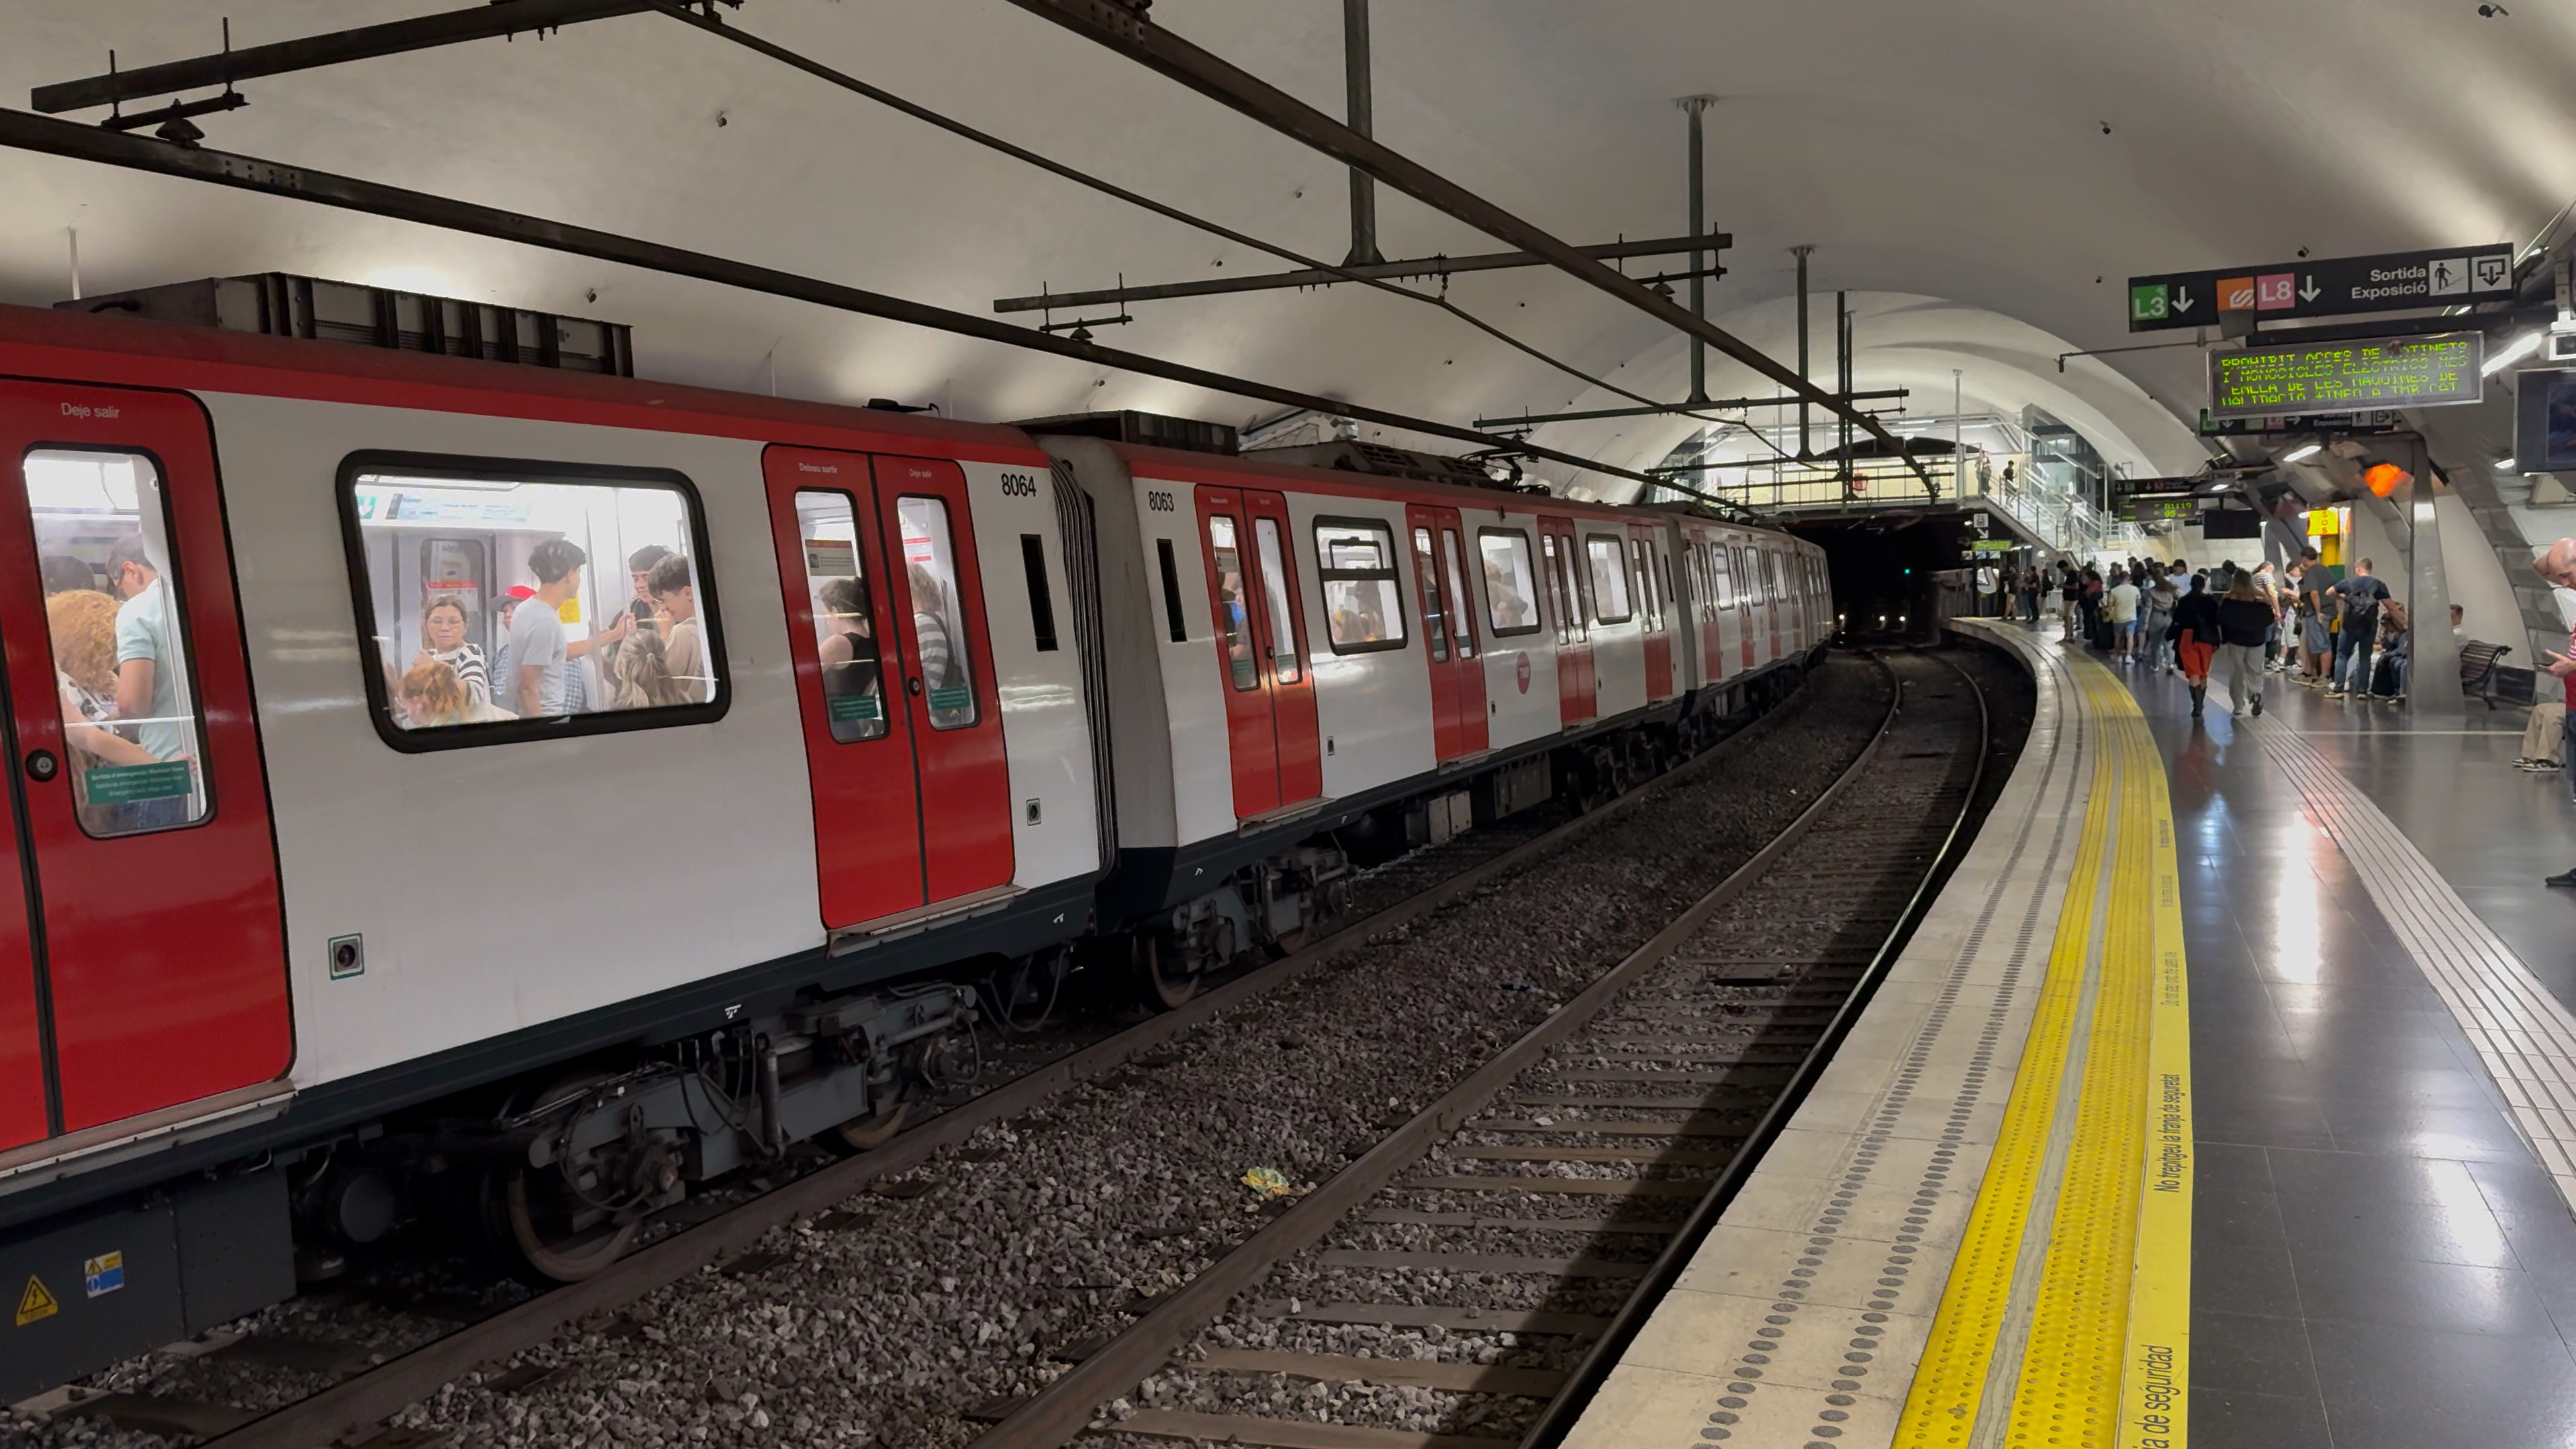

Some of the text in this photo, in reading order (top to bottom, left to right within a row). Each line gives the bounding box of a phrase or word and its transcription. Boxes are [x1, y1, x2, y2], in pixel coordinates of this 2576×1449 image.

[2370, 266, 2426, 282] Sortida
[2261, 281, 2291, 302] L8
[2351, 281, 2427, 300] Exposició
[2135, 296, 2165, 317] L3
[61, 403, 120, 419] Deje salir
[1001, 473, 1037, 497] 8064
[1149, 491, 1174, 511] 8063
[2159, 1073, 2186, 1103] seguretat
[2158, 1104, 2180, 1113] de
[2157, 1114, 2186, 1134] franja
[2156, 1144, 2187, 1179] trepitgeu
[2154, 1179, 2180, 1193] No
[2138, 1344, 2181, 1411] seguridad
[2134, 1414, 2170, 1434] de
